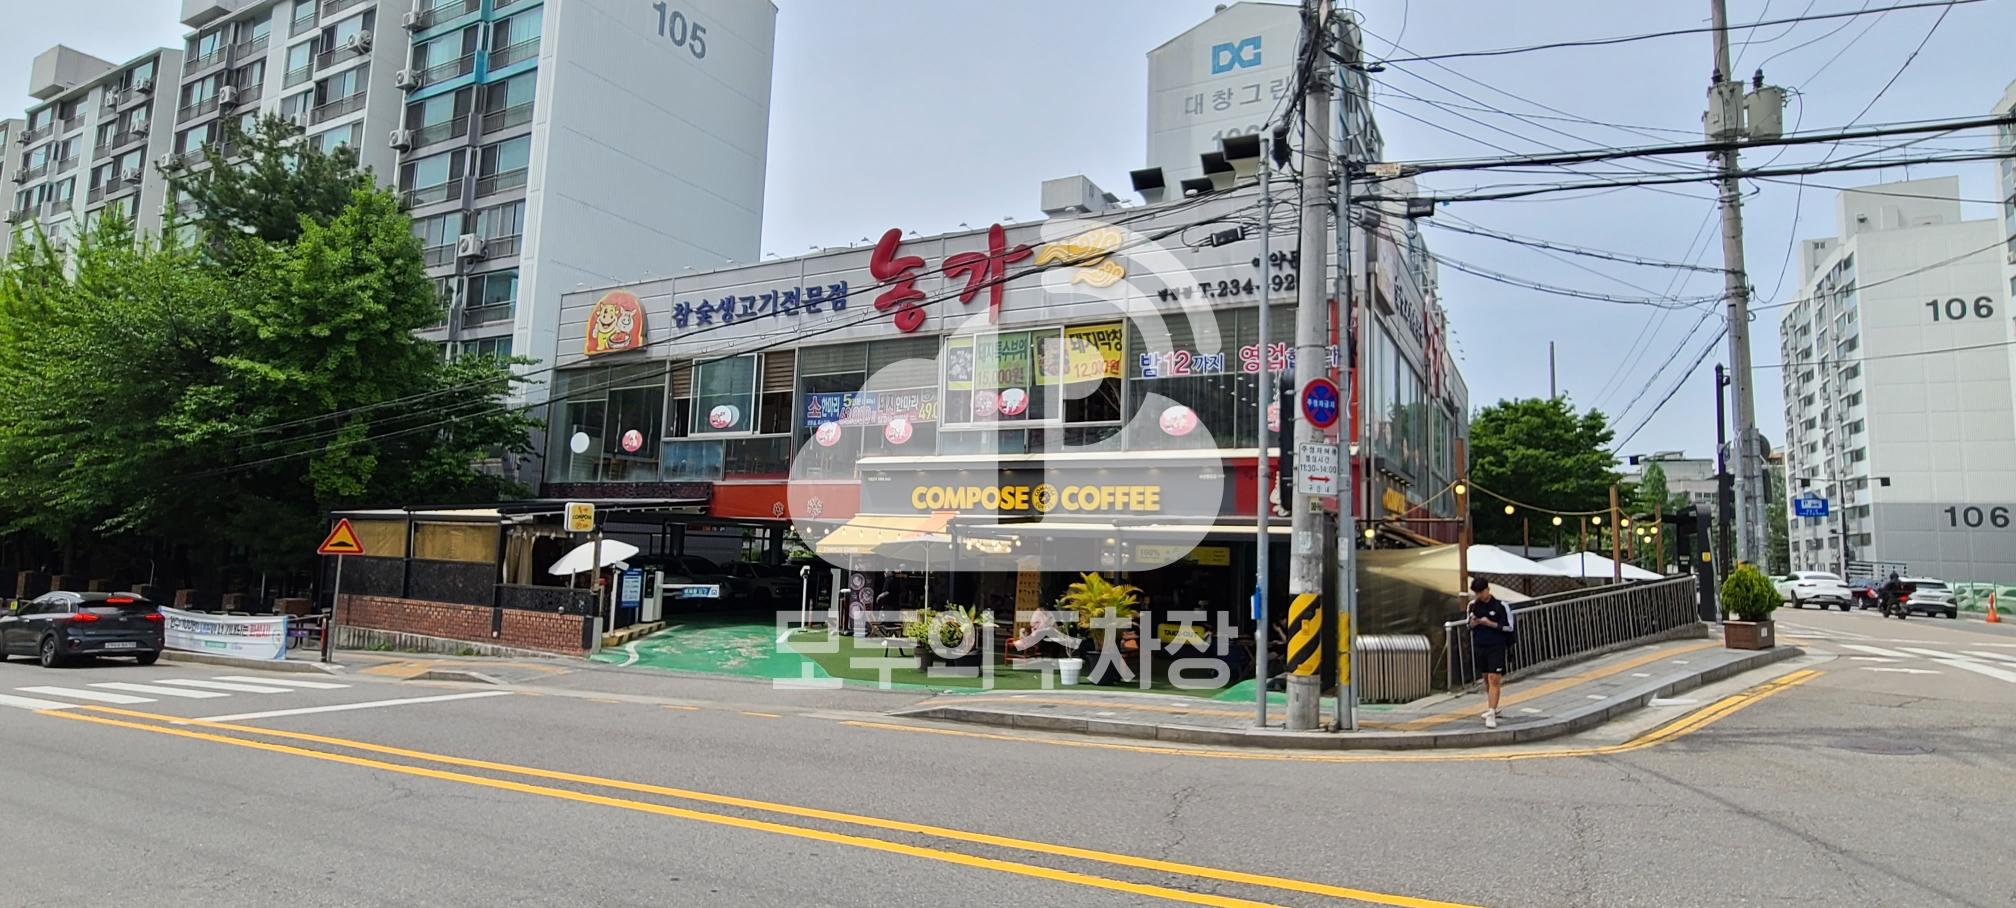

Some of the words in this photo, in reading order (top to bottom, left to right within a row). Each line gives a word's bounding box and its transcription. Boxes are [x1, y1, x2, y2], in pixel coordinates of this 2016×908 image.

[652, 0, 706, 59] 105
[1212, 35, 1262, 75] DG
[870, 223, 1034, 332] 농가
[672, 280, 848, 329] 참숯생고기전문점
[1925, 295, 1994, 322] 106
[911, 485, 1030, 511] COMPOSE
[1060, 485, 1161, 511] COFFEE
[1944, 505, 2010, 528] 106
